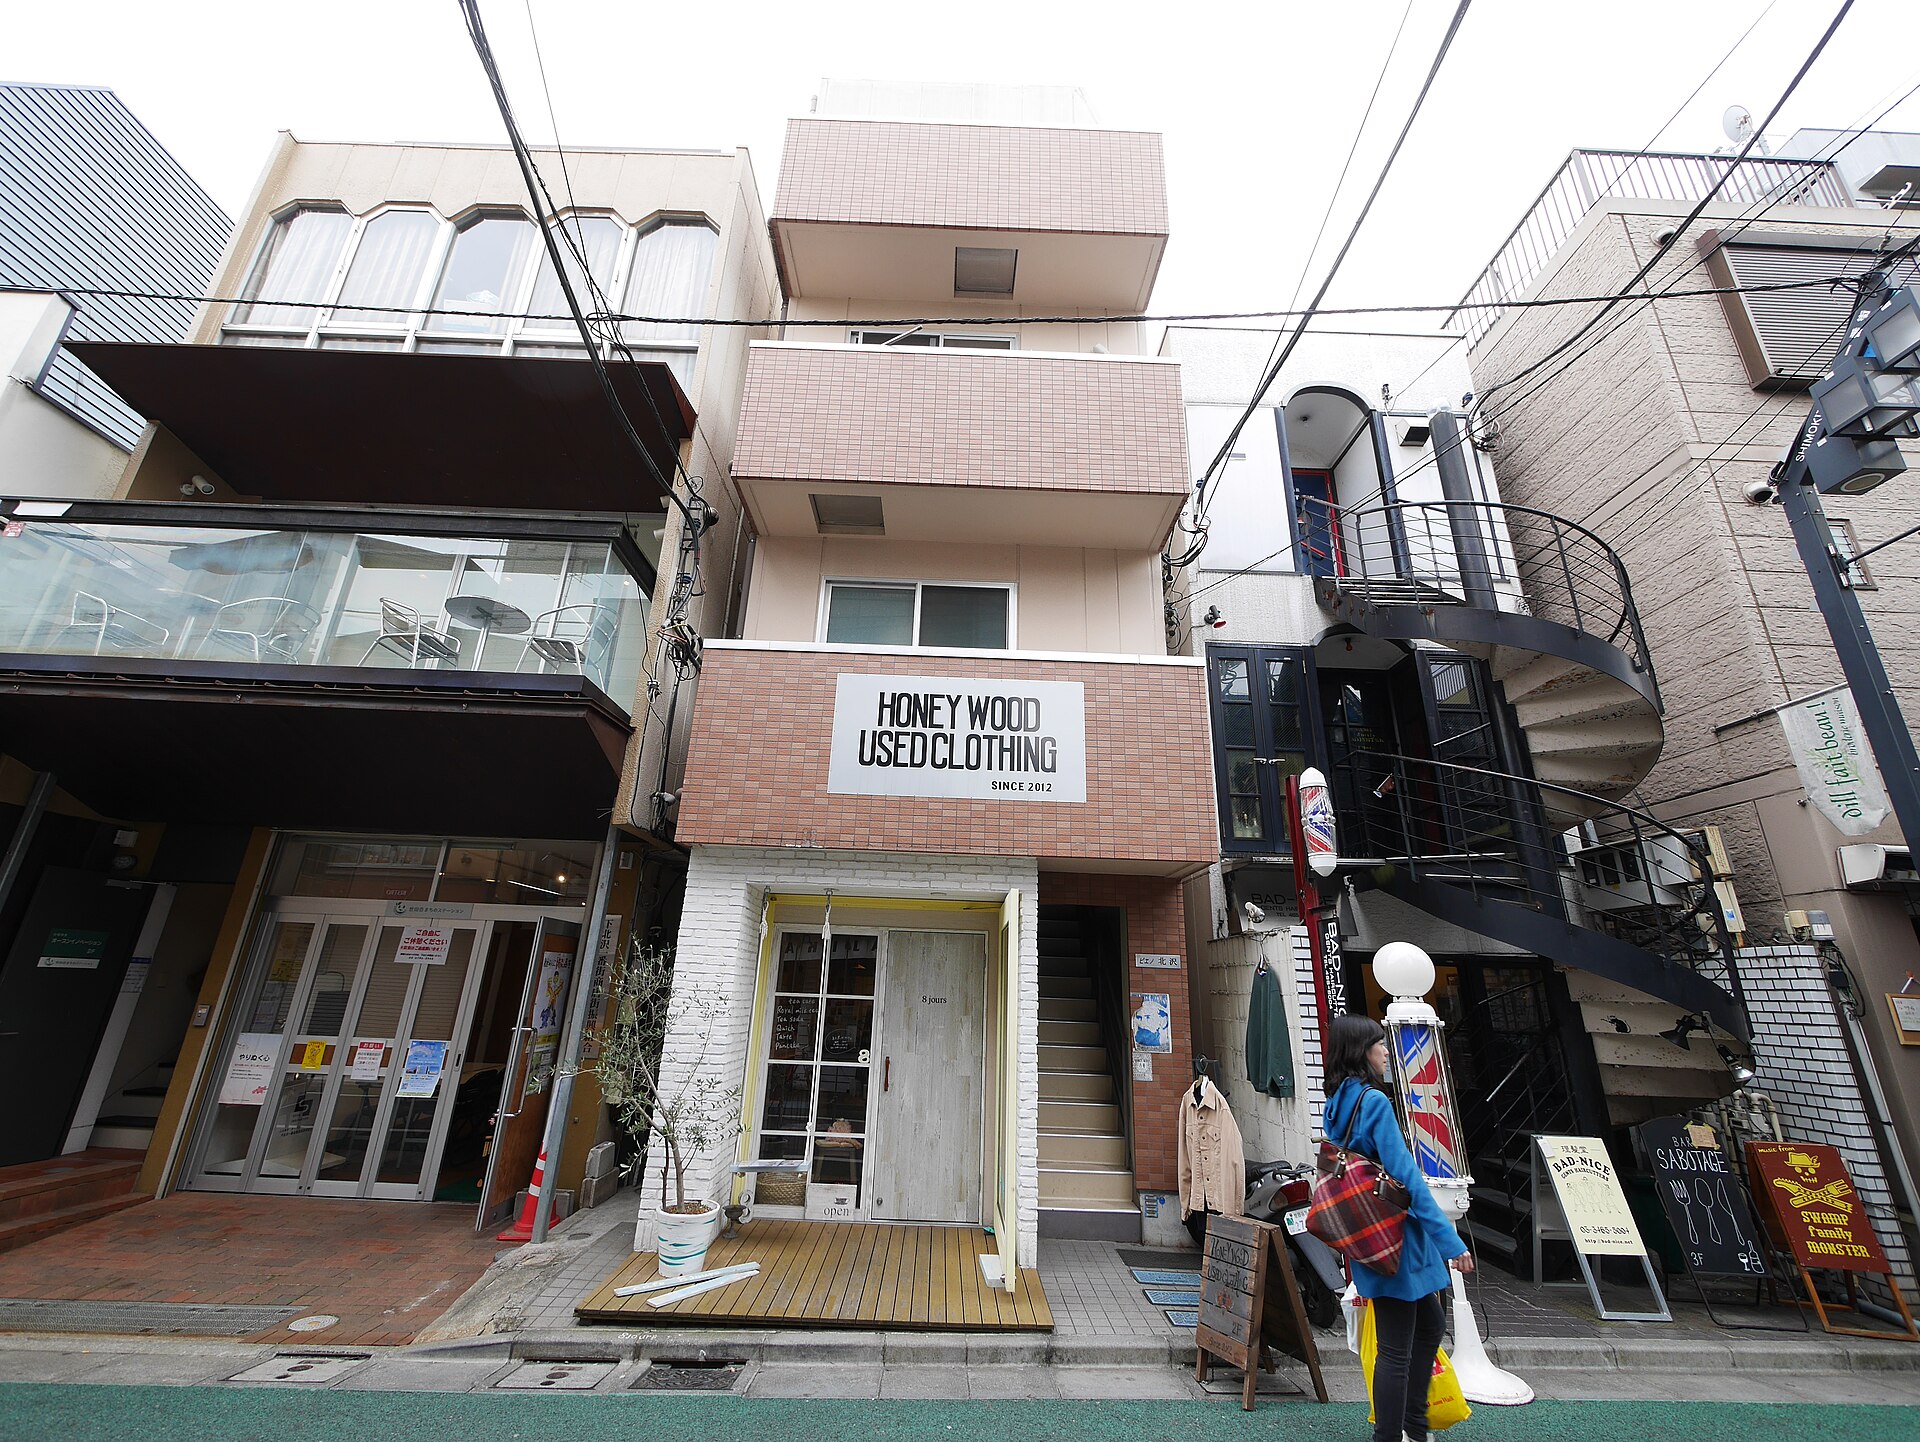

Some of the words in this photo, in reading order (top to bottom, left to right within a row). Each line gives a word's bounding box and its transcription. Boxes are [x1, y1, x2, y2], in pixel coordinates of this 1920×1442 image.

[877, 692, 962, 729] HONEY
[967, 695, 1041, 732] WOOD
[1814, 710, 1839, 752] beau
[858, 730, 928, 768] USED
[930, 733, 1057, 773] CLOTHING
[1824, 752, 1859, 786] fait
[991, 780, 1025, 791] SINCE
[1027, 782, 1053, 793] 2012
[1829, 790, 1862, 819] dill
[403, 937, 448, 945] ご休憩ください
[415, 929, 441, 937] ご自由に
[1158, 957, 1178, 966] 北沢
[1327, 921, 1347, 1017] BAD-NIC
[921, 995, 928, 1003] 8
[928, 995, 948, 1004] jours
[1671, 1136, 1693, 1148] BAR
[1552, 1156, 1611, 1176] BAD-NICE
[1656, 1148, 1729, 1173] SABOTAGE
[823, 1206, 850, 1218] open
[1808, 1225, 1853, 1242] family
[1806, 1241, 1871, 1258] MONSTER
[1690, 1251, 1703, 1266] 3F
[1231, 1321, 1243, 1336] 2F
